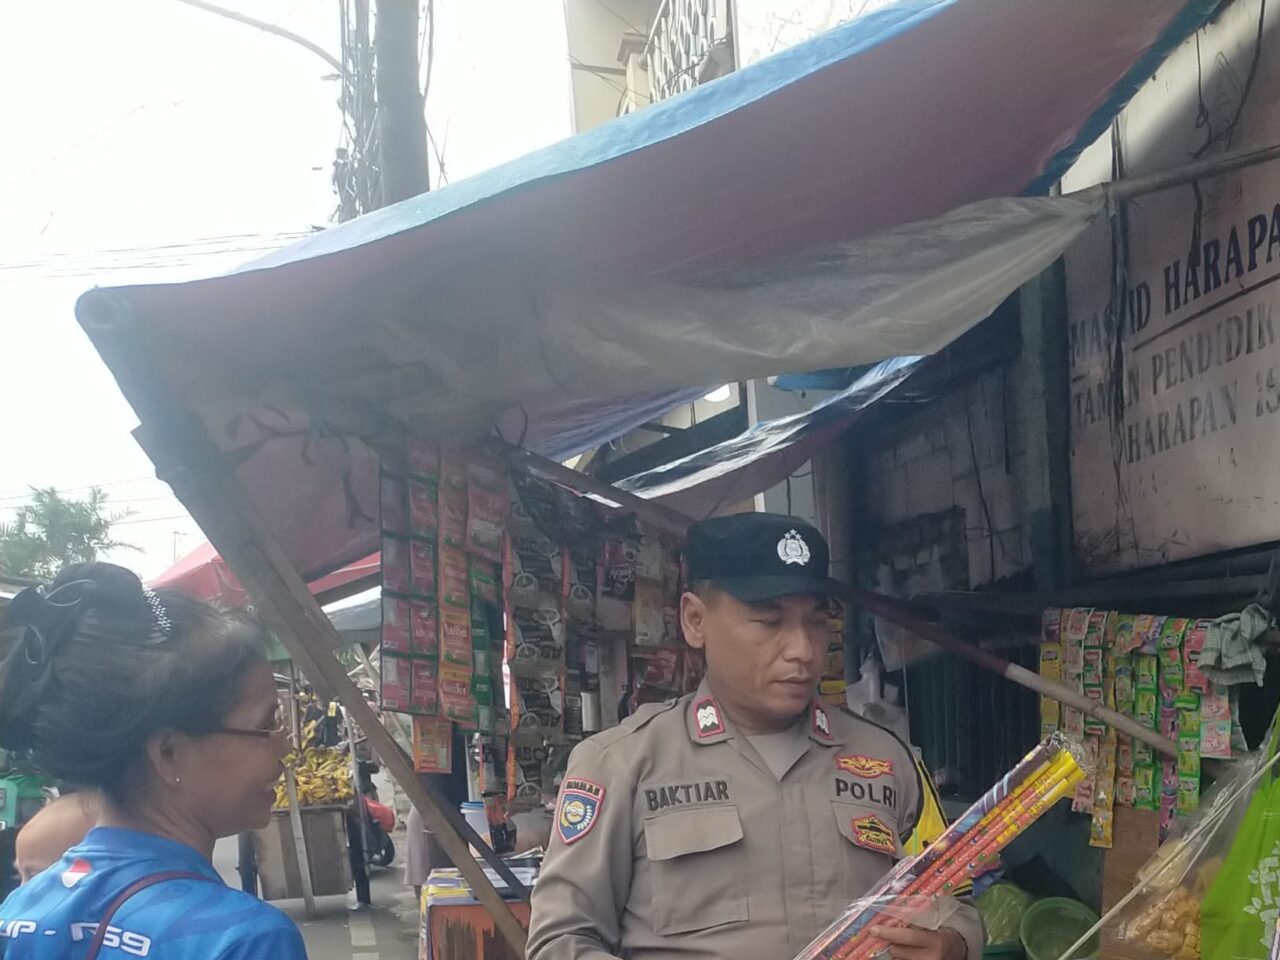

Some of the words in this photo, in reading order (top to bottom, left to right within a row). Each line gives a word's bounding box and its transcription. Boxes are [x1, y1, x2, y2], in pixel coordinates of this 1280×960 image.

[1126, 379, 1238, 466] HARAPAN
[644, 779, 730, 811] BAKTIAR
[834, 778, 897, 810] POLRI
